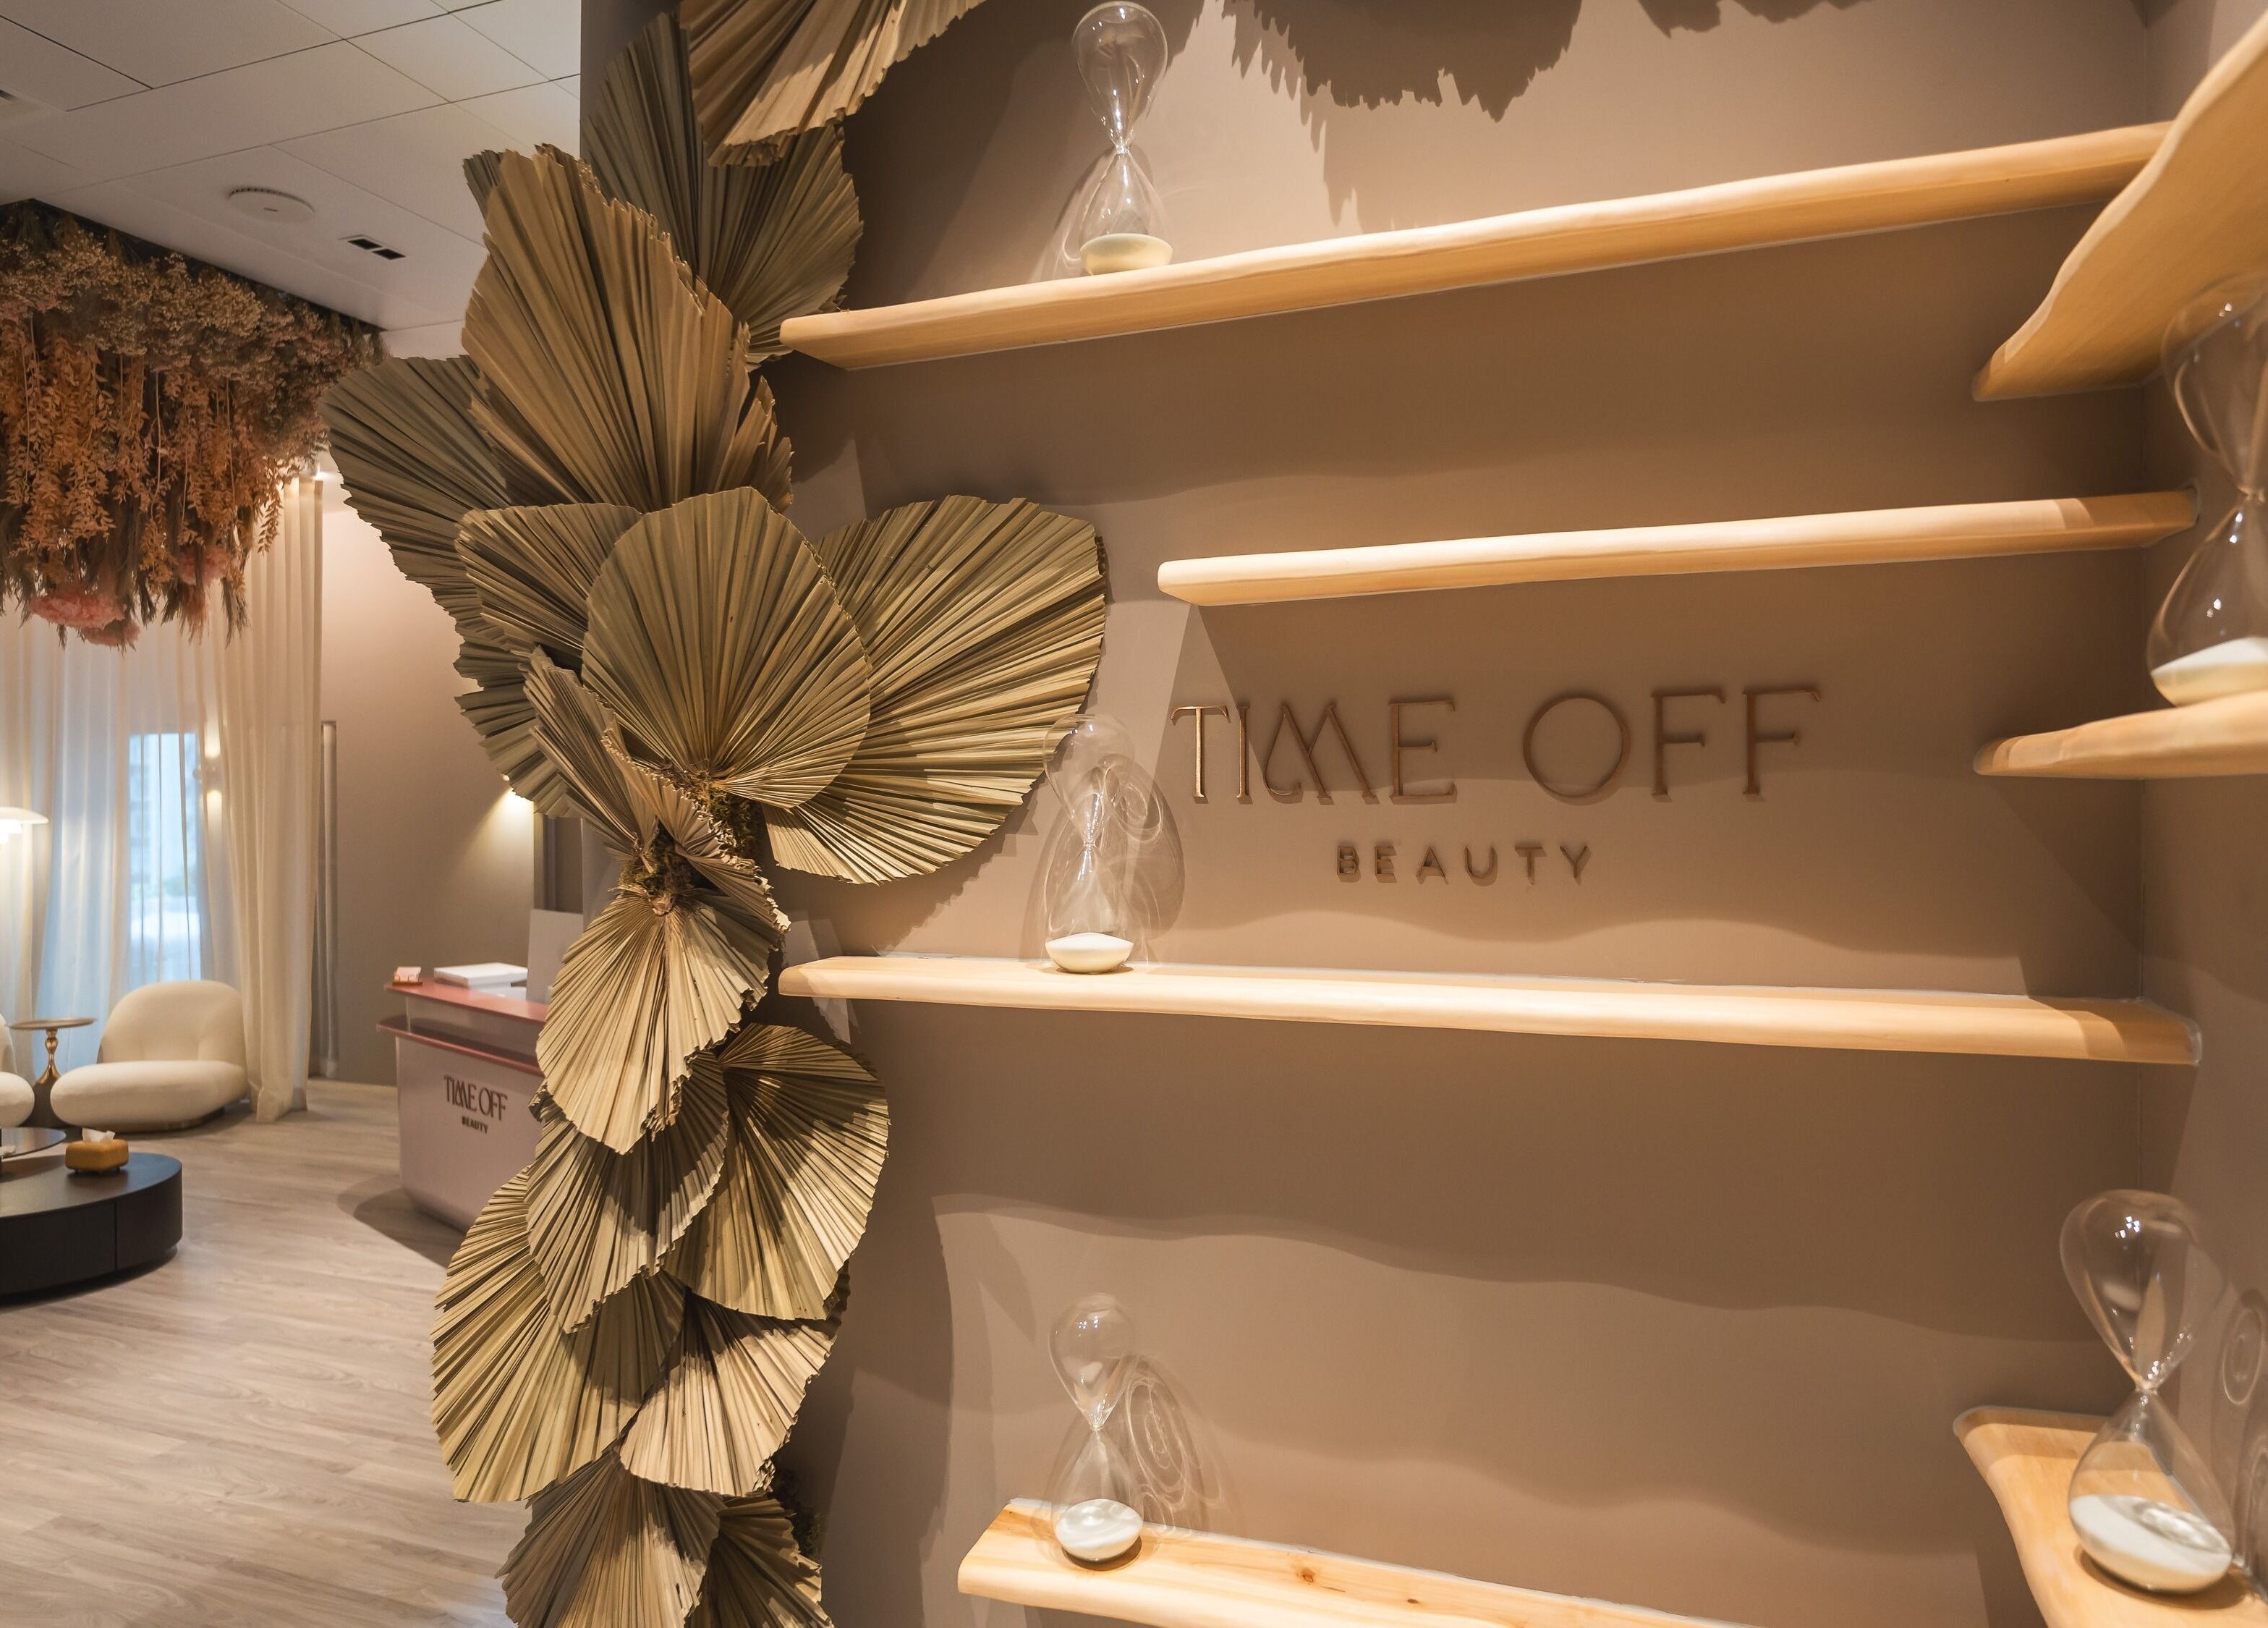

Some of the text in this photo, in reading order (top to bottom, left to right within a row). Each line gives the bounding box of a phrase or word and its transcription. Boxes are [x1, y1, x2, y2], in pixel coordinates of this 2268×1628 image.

[1171, 688, 1822, 801] TIME OFF
[1336, 844, 1591, 883] BEAUTY
[443, 1074, 508, 1121] TIME OFF
[462, 1115, 488, 1134] BEAUTY
